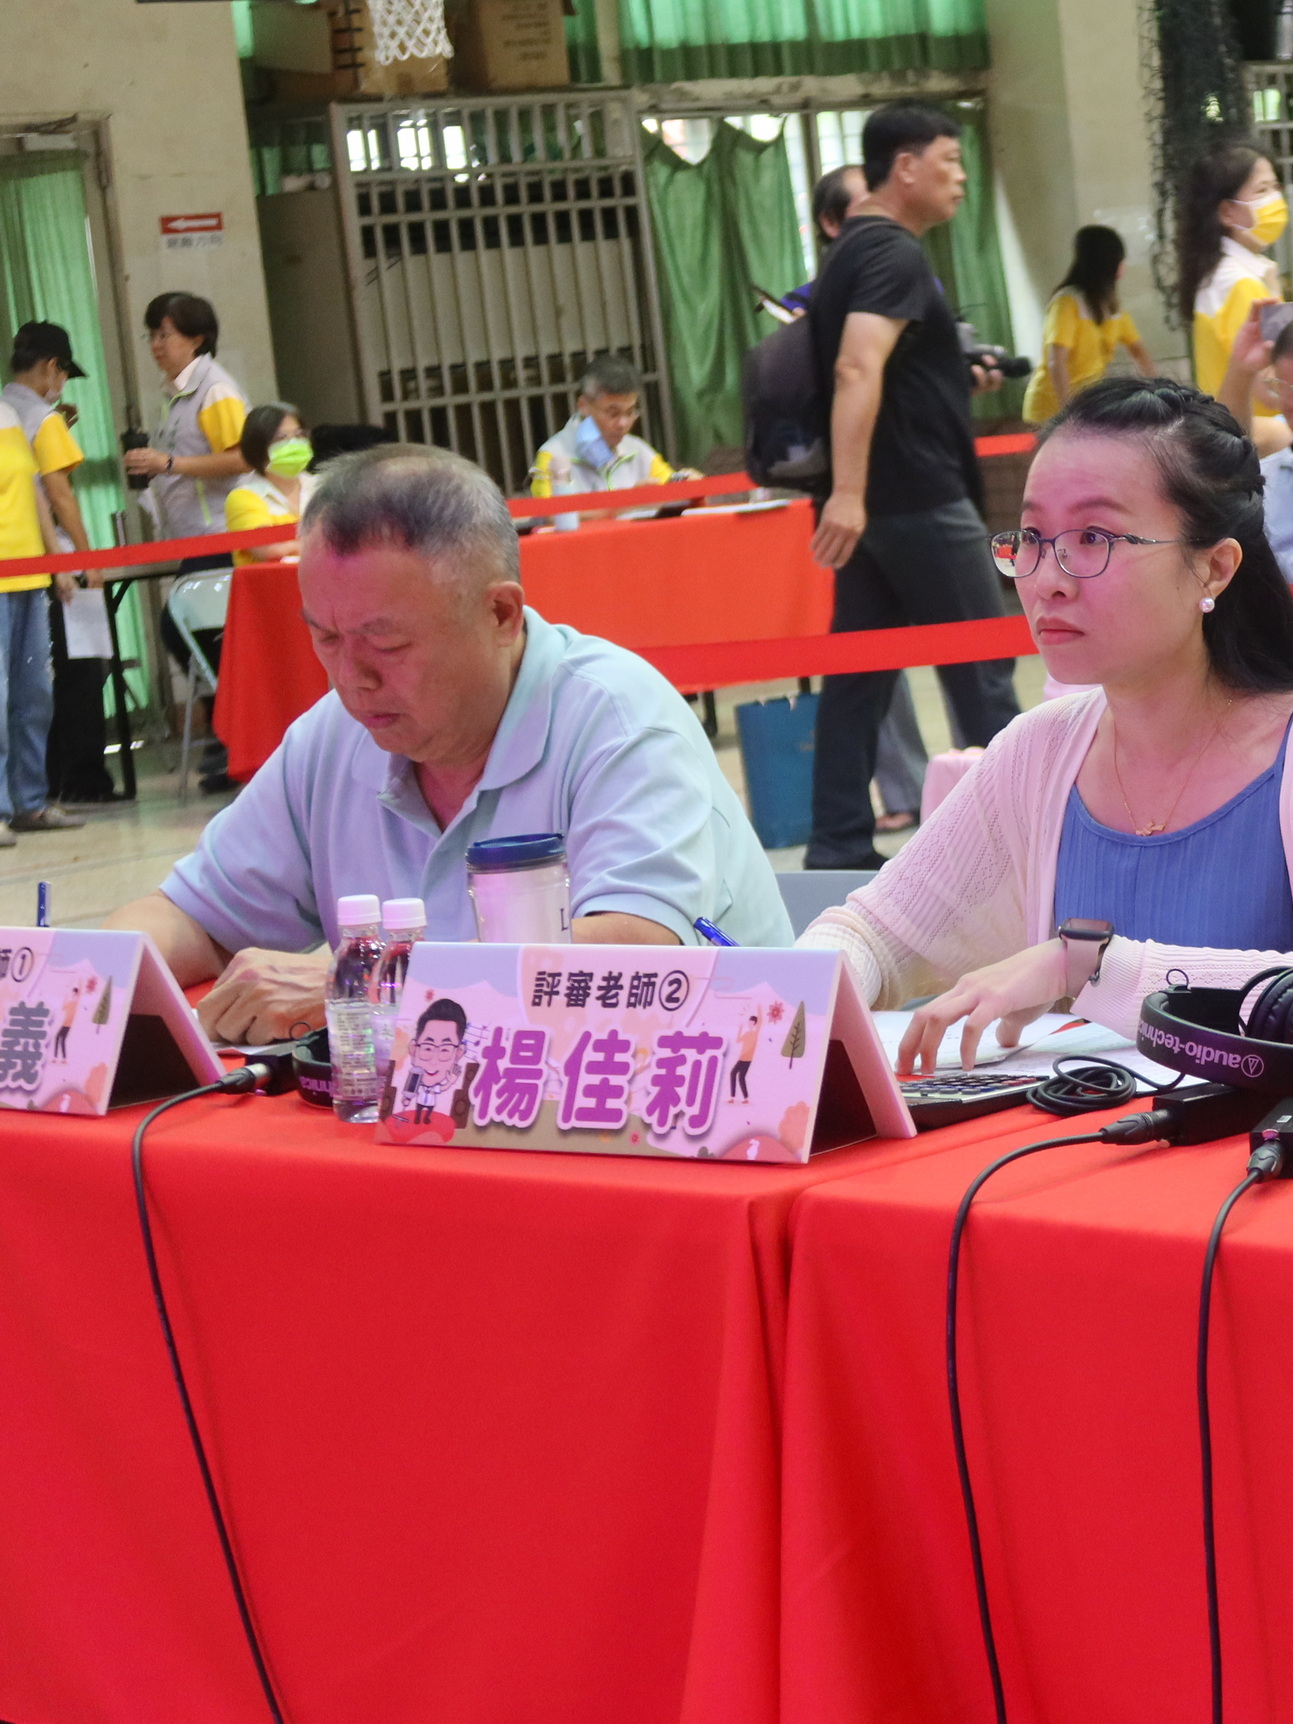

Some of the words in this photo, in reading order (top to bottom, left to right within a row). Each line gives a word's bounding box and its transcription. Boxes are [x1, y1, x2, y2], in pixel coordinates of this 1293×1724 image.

[530, 969, 691, 1012] 評審老師②
[0, 1001, 50, 1085] 義
[472, 1026, 724, 1131] 楊佳莉
